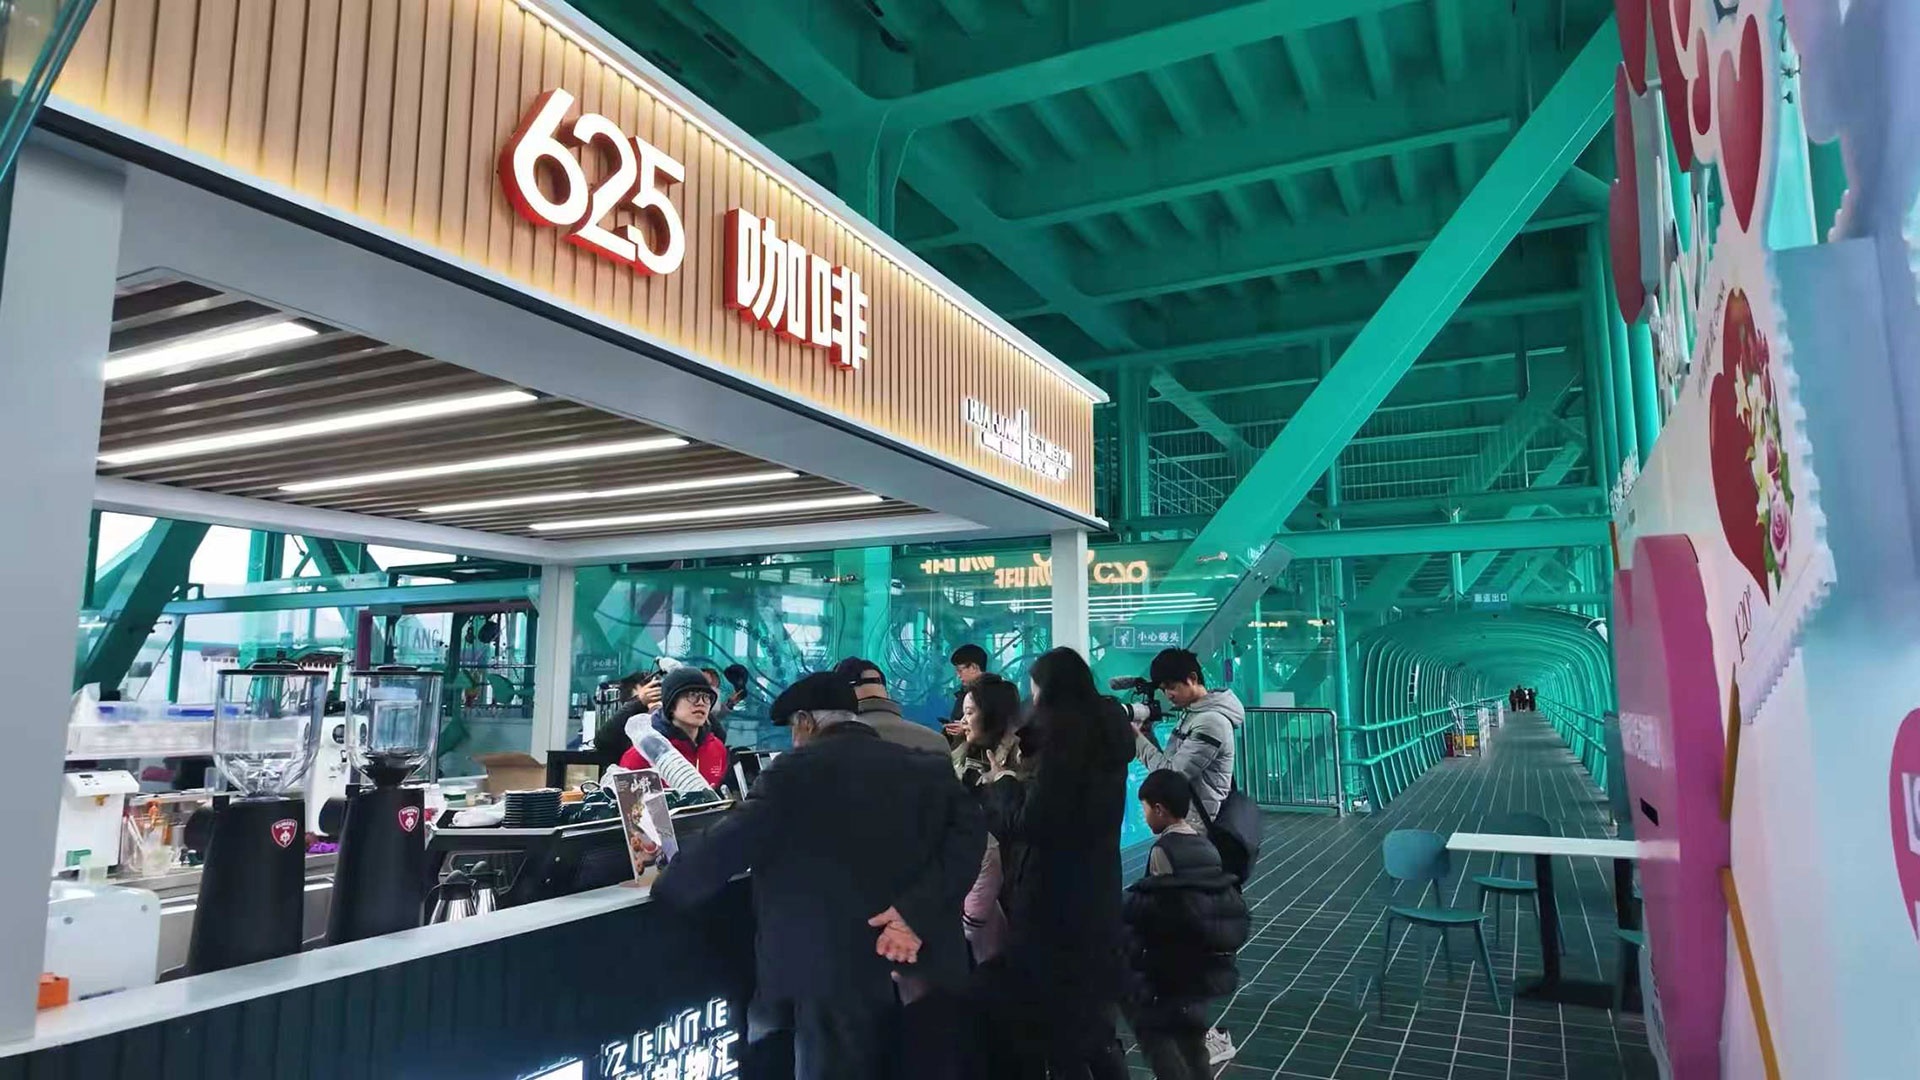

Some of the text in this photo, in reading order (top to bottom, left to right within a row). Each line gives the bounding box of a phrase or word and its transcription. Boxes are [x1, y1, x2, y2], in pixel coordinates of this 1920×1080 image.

[503, 87, 685, 275] 625
[725, 207, 868, 370] 咖啡
[1474, 593, 1508, 603] 出口
